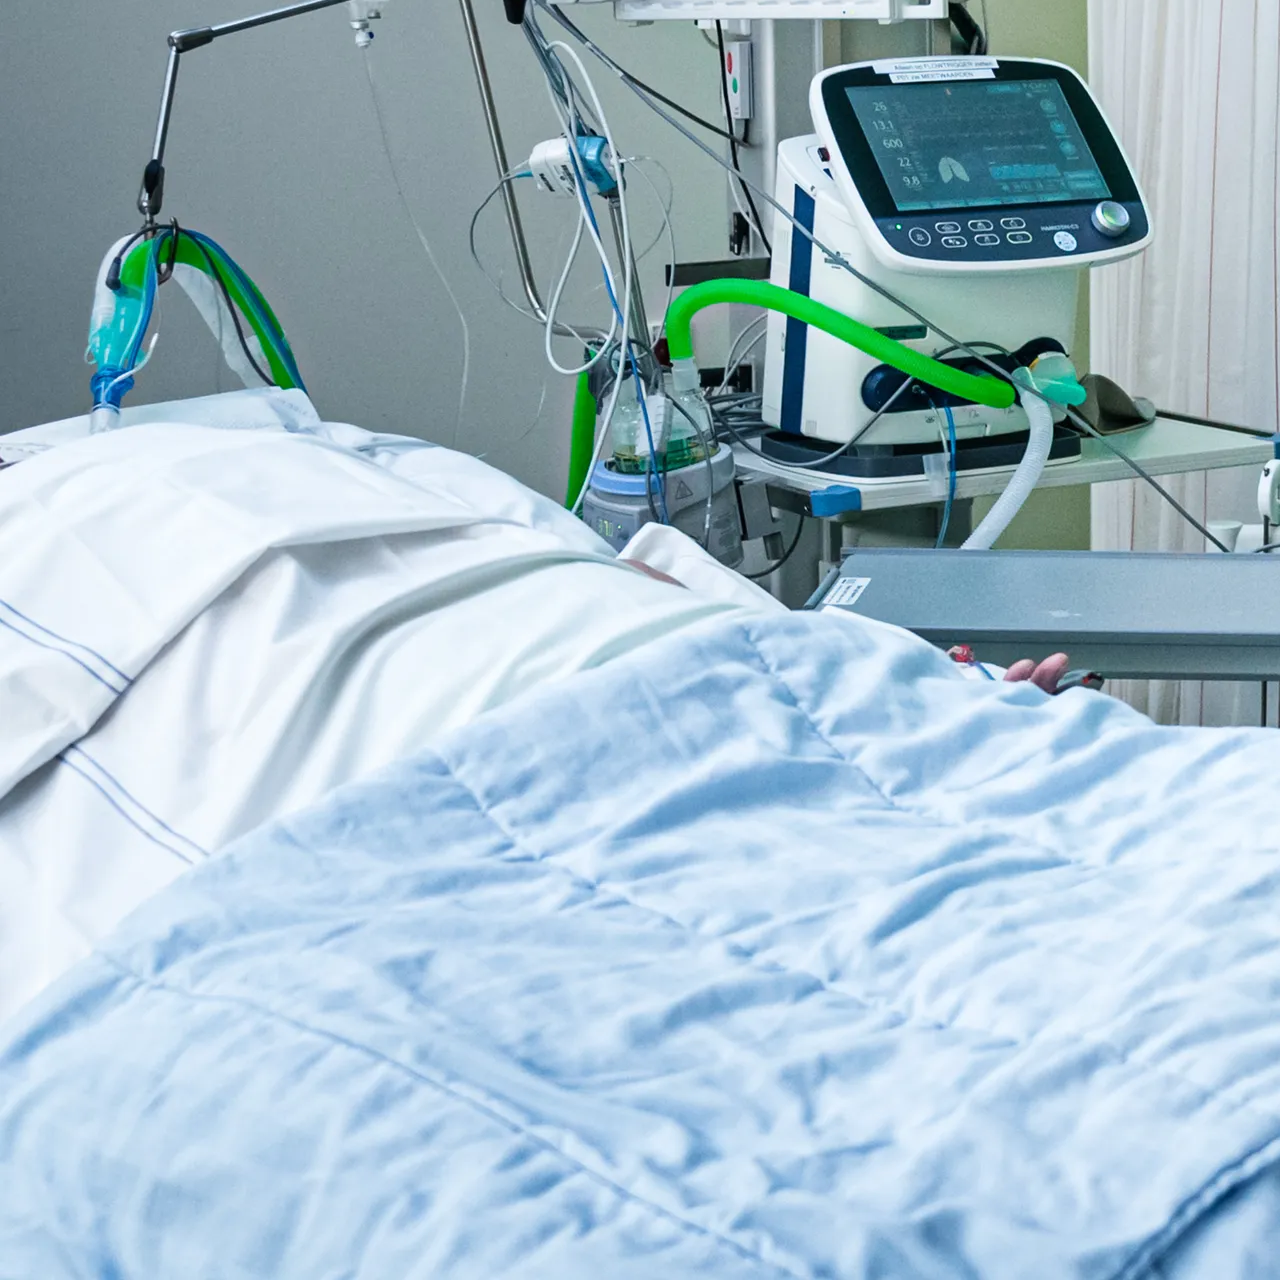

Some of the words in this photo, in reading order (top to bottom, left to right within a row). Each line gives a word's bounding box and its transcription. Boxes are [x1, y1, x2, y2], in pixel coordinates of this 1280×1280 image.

[873, 101, 887, 112] 26
[872, 120, 894, 130] 13.1
[883, 138, 903, 149] 600
[897, 157, 911, 167] 22
